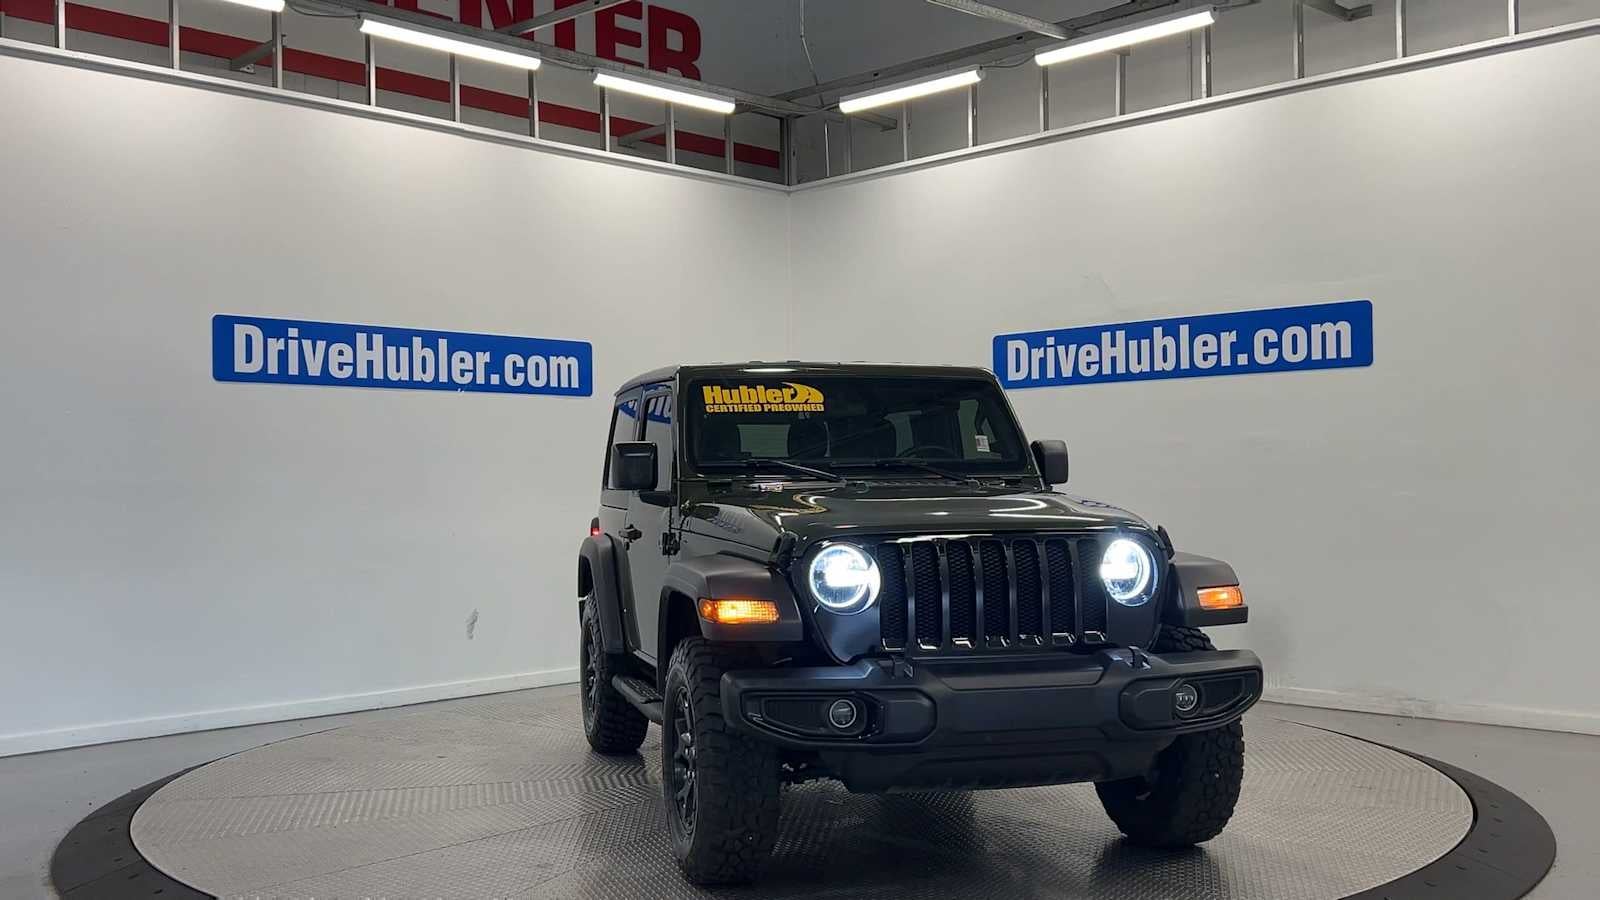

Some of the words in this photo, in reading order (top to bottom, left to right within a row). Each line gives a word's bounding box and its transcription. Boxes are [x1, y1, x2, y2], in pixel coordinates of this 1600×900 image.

[366, 0, 701, 81] NTER
[233, 323, 580, 389] DriveHubler.com
[1006, 320, 1352, 381] DriveHubler.com
[702, 385, 796, 404] Hubler
[706, 404, 762, 413] CERTIFIED
[763, 403, 825, 412] PREOWNED
